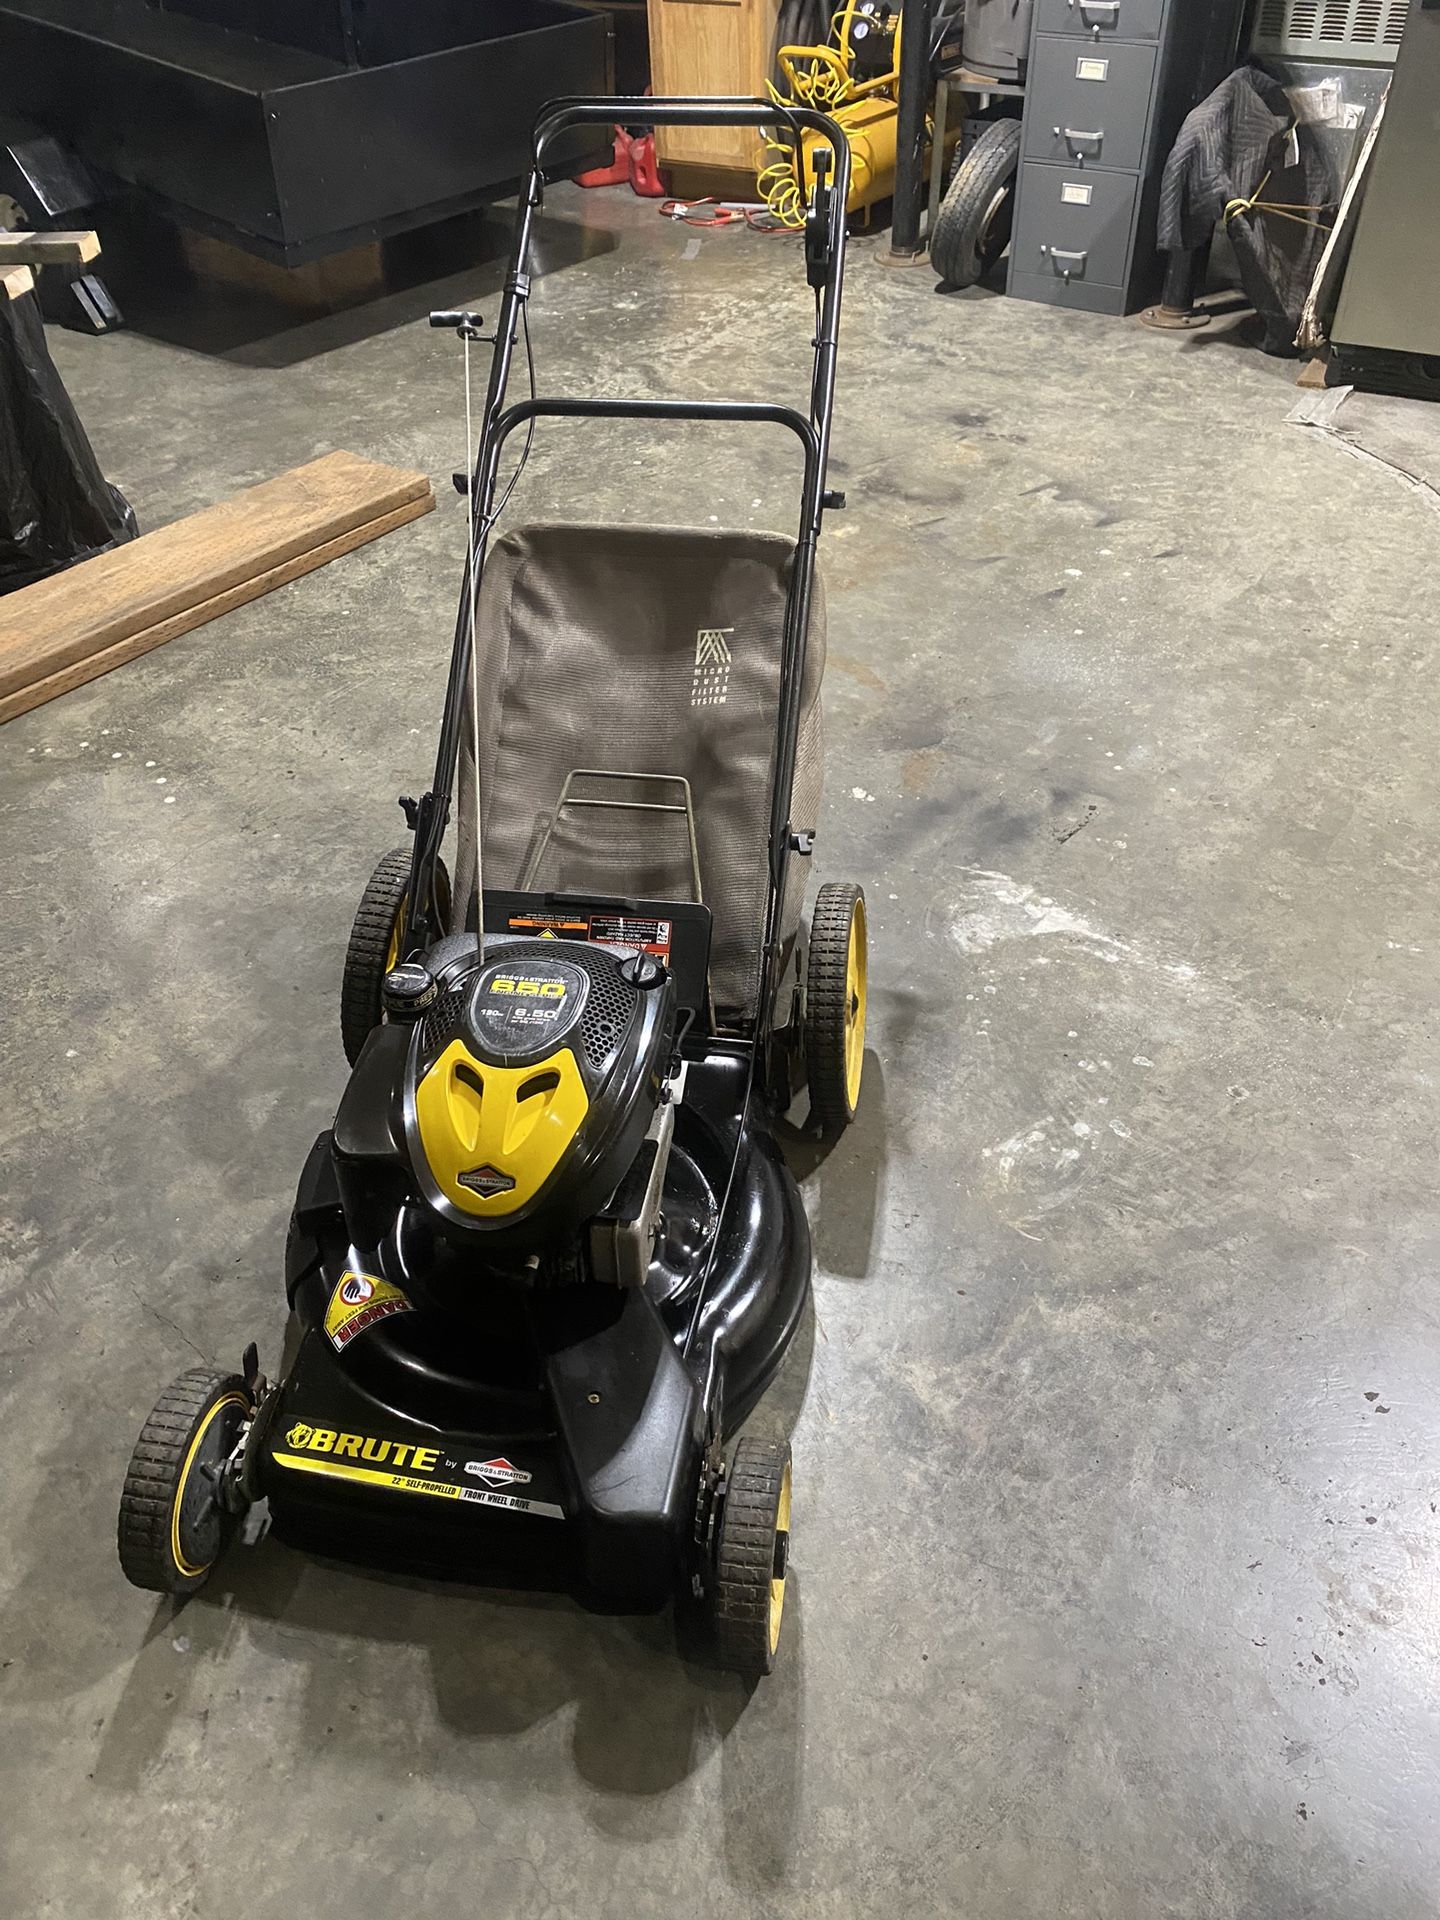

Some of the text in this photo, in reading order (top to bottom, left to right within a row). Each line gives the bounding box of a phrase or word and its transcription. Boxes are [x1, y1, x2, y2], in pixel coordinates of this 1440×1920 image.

[695, 666, 730, 675] MICRO
[693, 676, 729, 685] DUST
[691, 686, 728, 696] FILTER
[690, 696, 727, 706] SYSTEM
[491, 979, 566, 997] 650
[514, 1008, 557, 1019] 6.50
[338, 1301, 409, 1342] DANGER
[306, 1427, 457, 1472] BRUTE by
[406, 1479, 457, 1495] SELF-PROPELLED
[464, 1490, 487, 1501] FRONT
[487, 1494, 507, 1506] WHEEL
[509, 1498, 530, 1510] DRIVE
